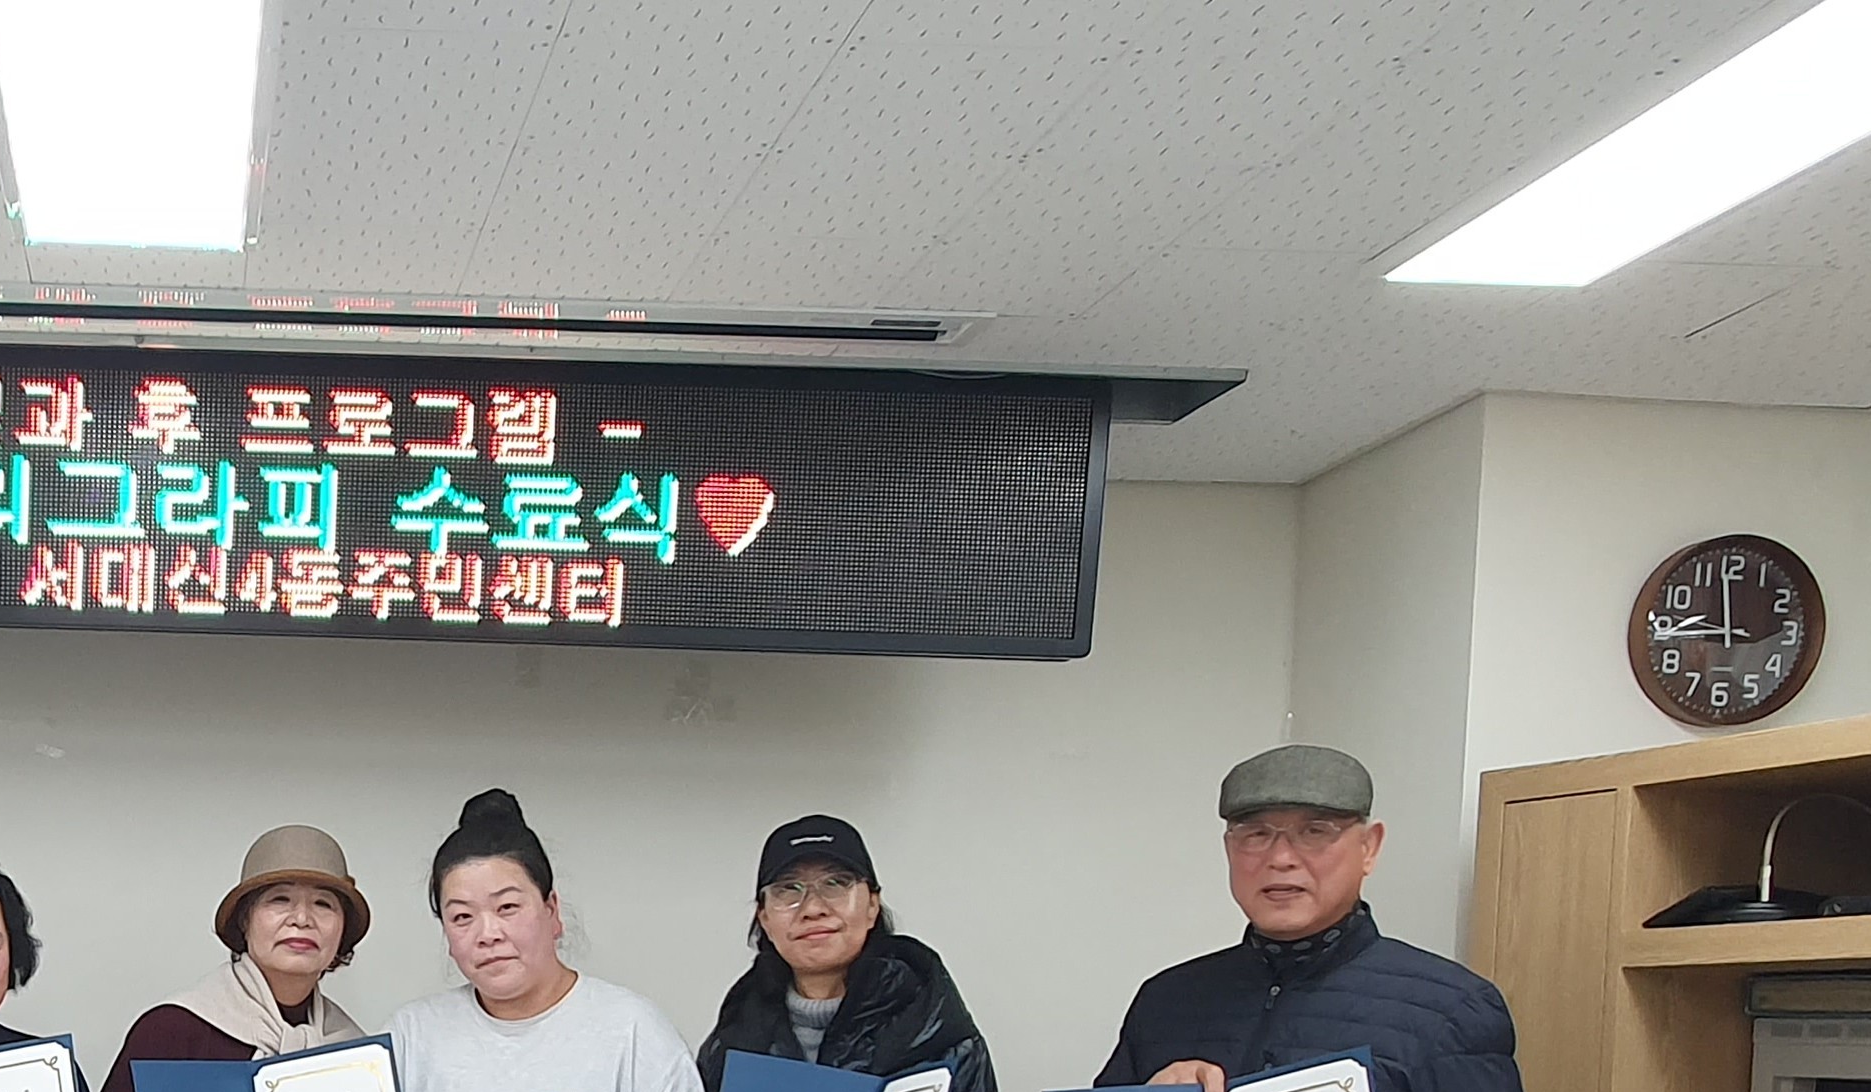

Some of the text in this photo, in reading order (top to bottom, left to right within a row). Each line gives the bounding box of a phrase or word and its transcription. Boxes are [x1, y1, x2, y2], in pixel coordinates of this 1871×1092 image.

[127, 376, 202, 455] 후
[391, 466, 679, 565] 수료식
[22, 538, 624, 629] 서대신4동주민센터
[1694, 562, 1712, 587] 11
[1759, 562, 1767, 587] 1
[1665, 585, 1692, 609] 10
[1773, 588, 1791, 613] 2
[1780, 621, 1799, 646] 3
[1661, 649, 1680, 674] 8
[1765, 653, 1782, 678] 4
[1685, 672, 1702, 697] 7
[1710, 682, 1730, 707] 6
[1742, 674, 1761, 699] 5
